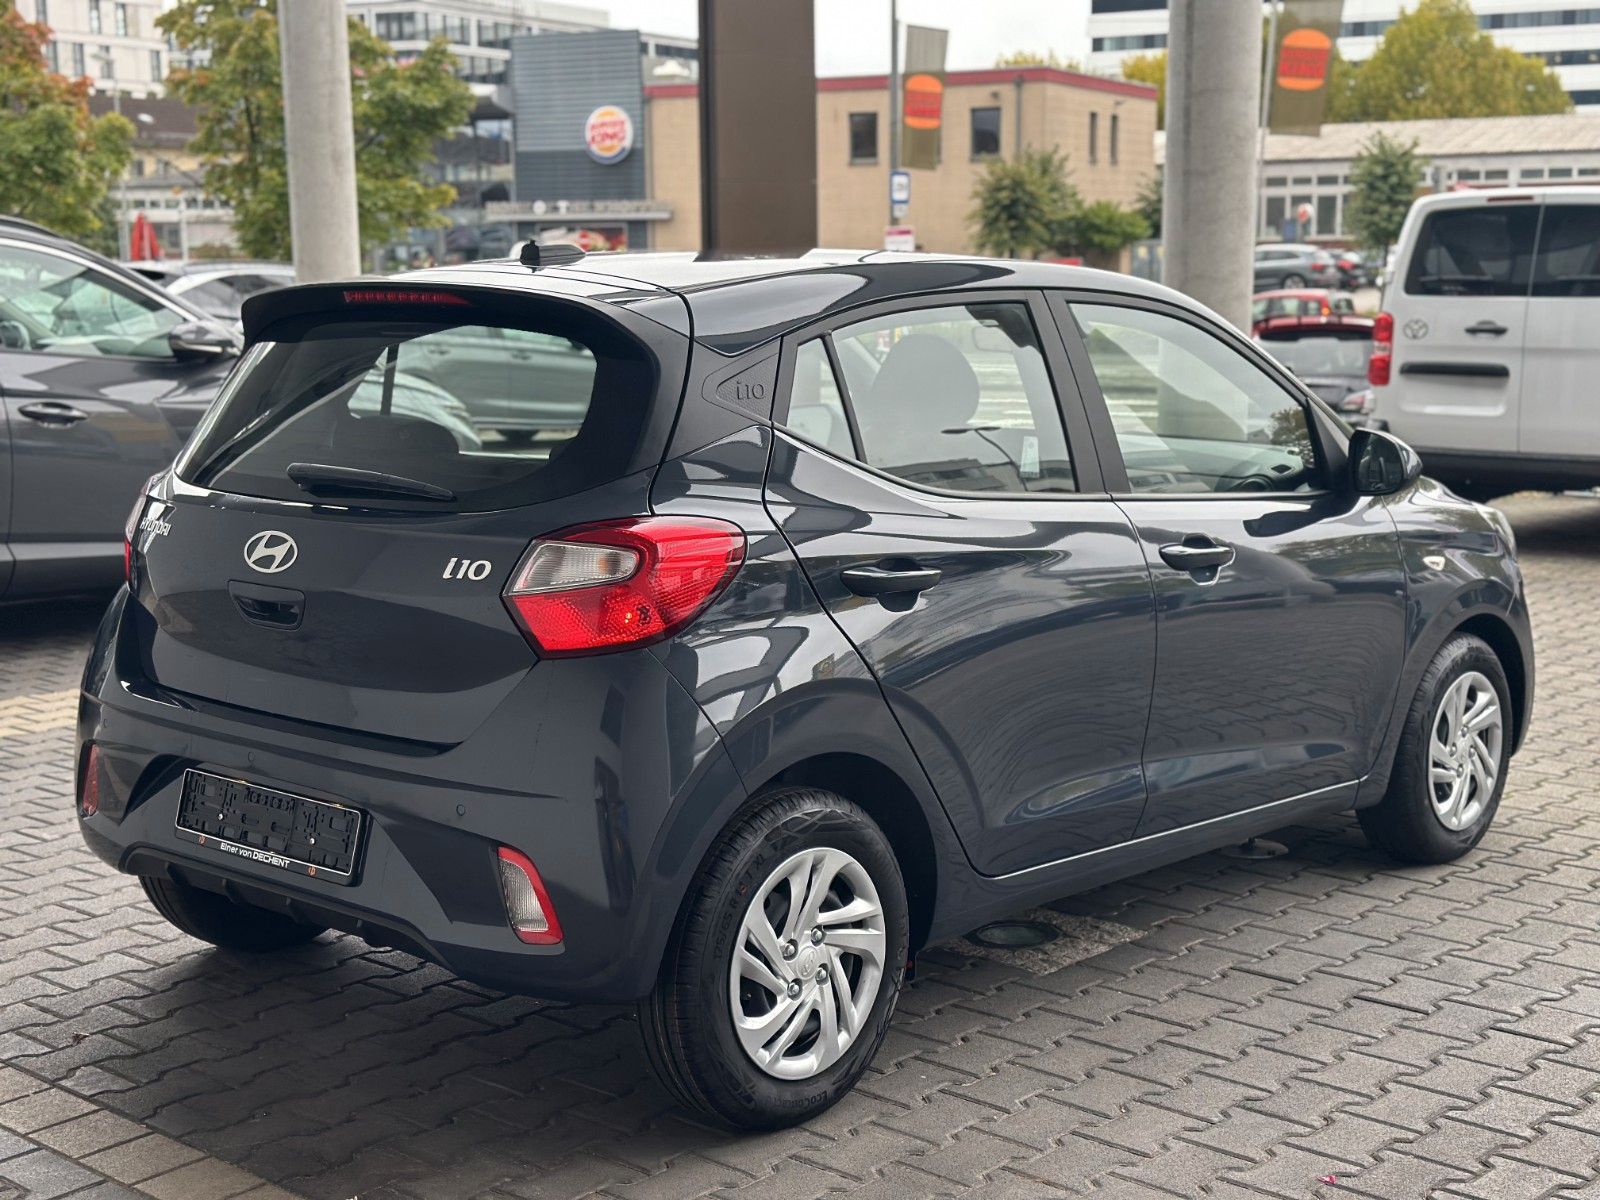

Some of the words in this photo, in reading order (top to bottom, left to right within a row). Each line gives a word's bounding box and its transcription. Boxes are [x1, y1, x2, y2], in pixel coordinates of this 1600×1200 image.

[736, 380, 765, 400] i10
[442, 557, 492, 580] i10
[220, 842, 239, 854] Einer
[239, 848, 252, 859] von
[252, 851, 290, 868] DECHENT
